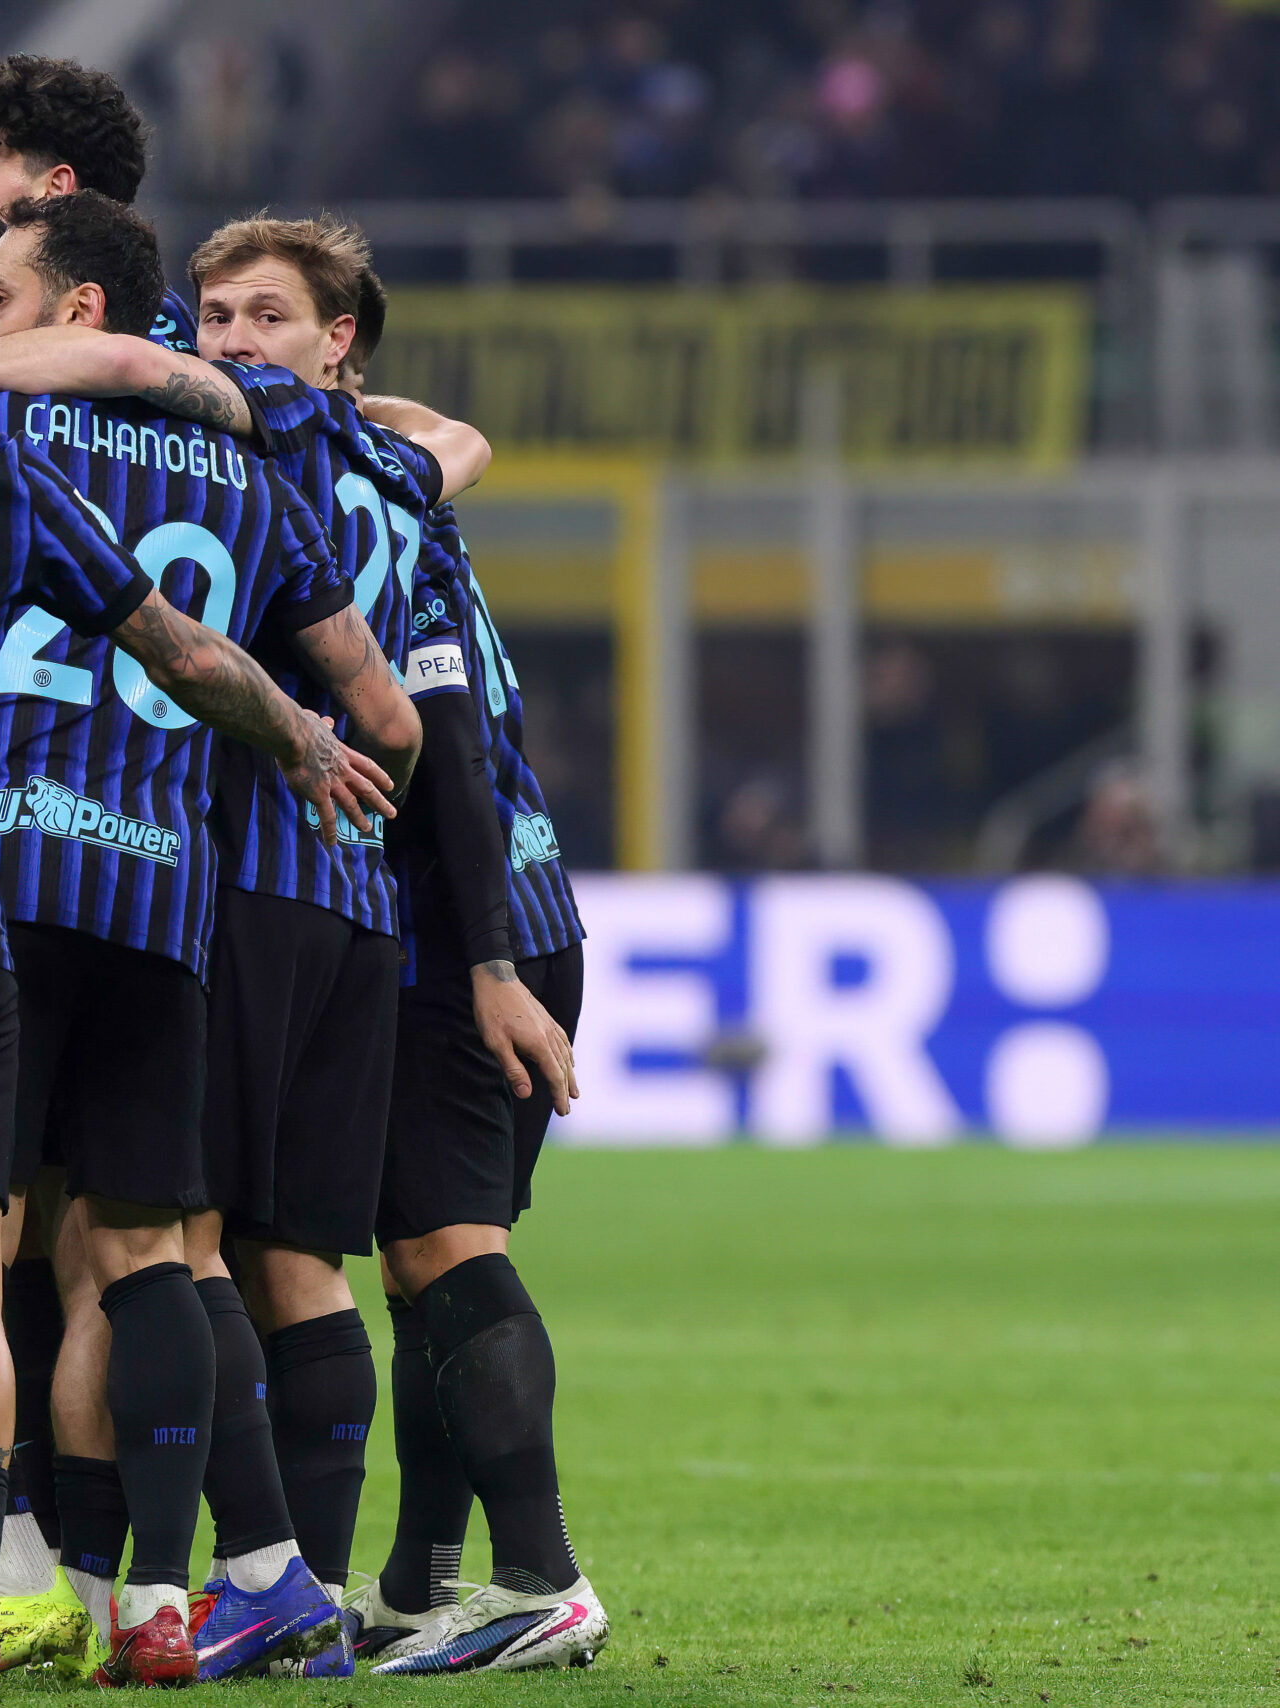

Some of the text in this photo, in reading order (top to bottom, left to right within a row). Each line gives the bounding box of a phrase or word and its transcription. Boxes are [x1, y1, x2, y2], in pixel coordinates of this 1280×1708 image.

[25, 403, 248, 490] ÇALHANOĞLU
[411, 598, 447, 636] e.io
[418, 656, 466, 678] PEAC
[153, 1427, 196, 1445] INTER
[332, 1424, 367, 1441] INTER
